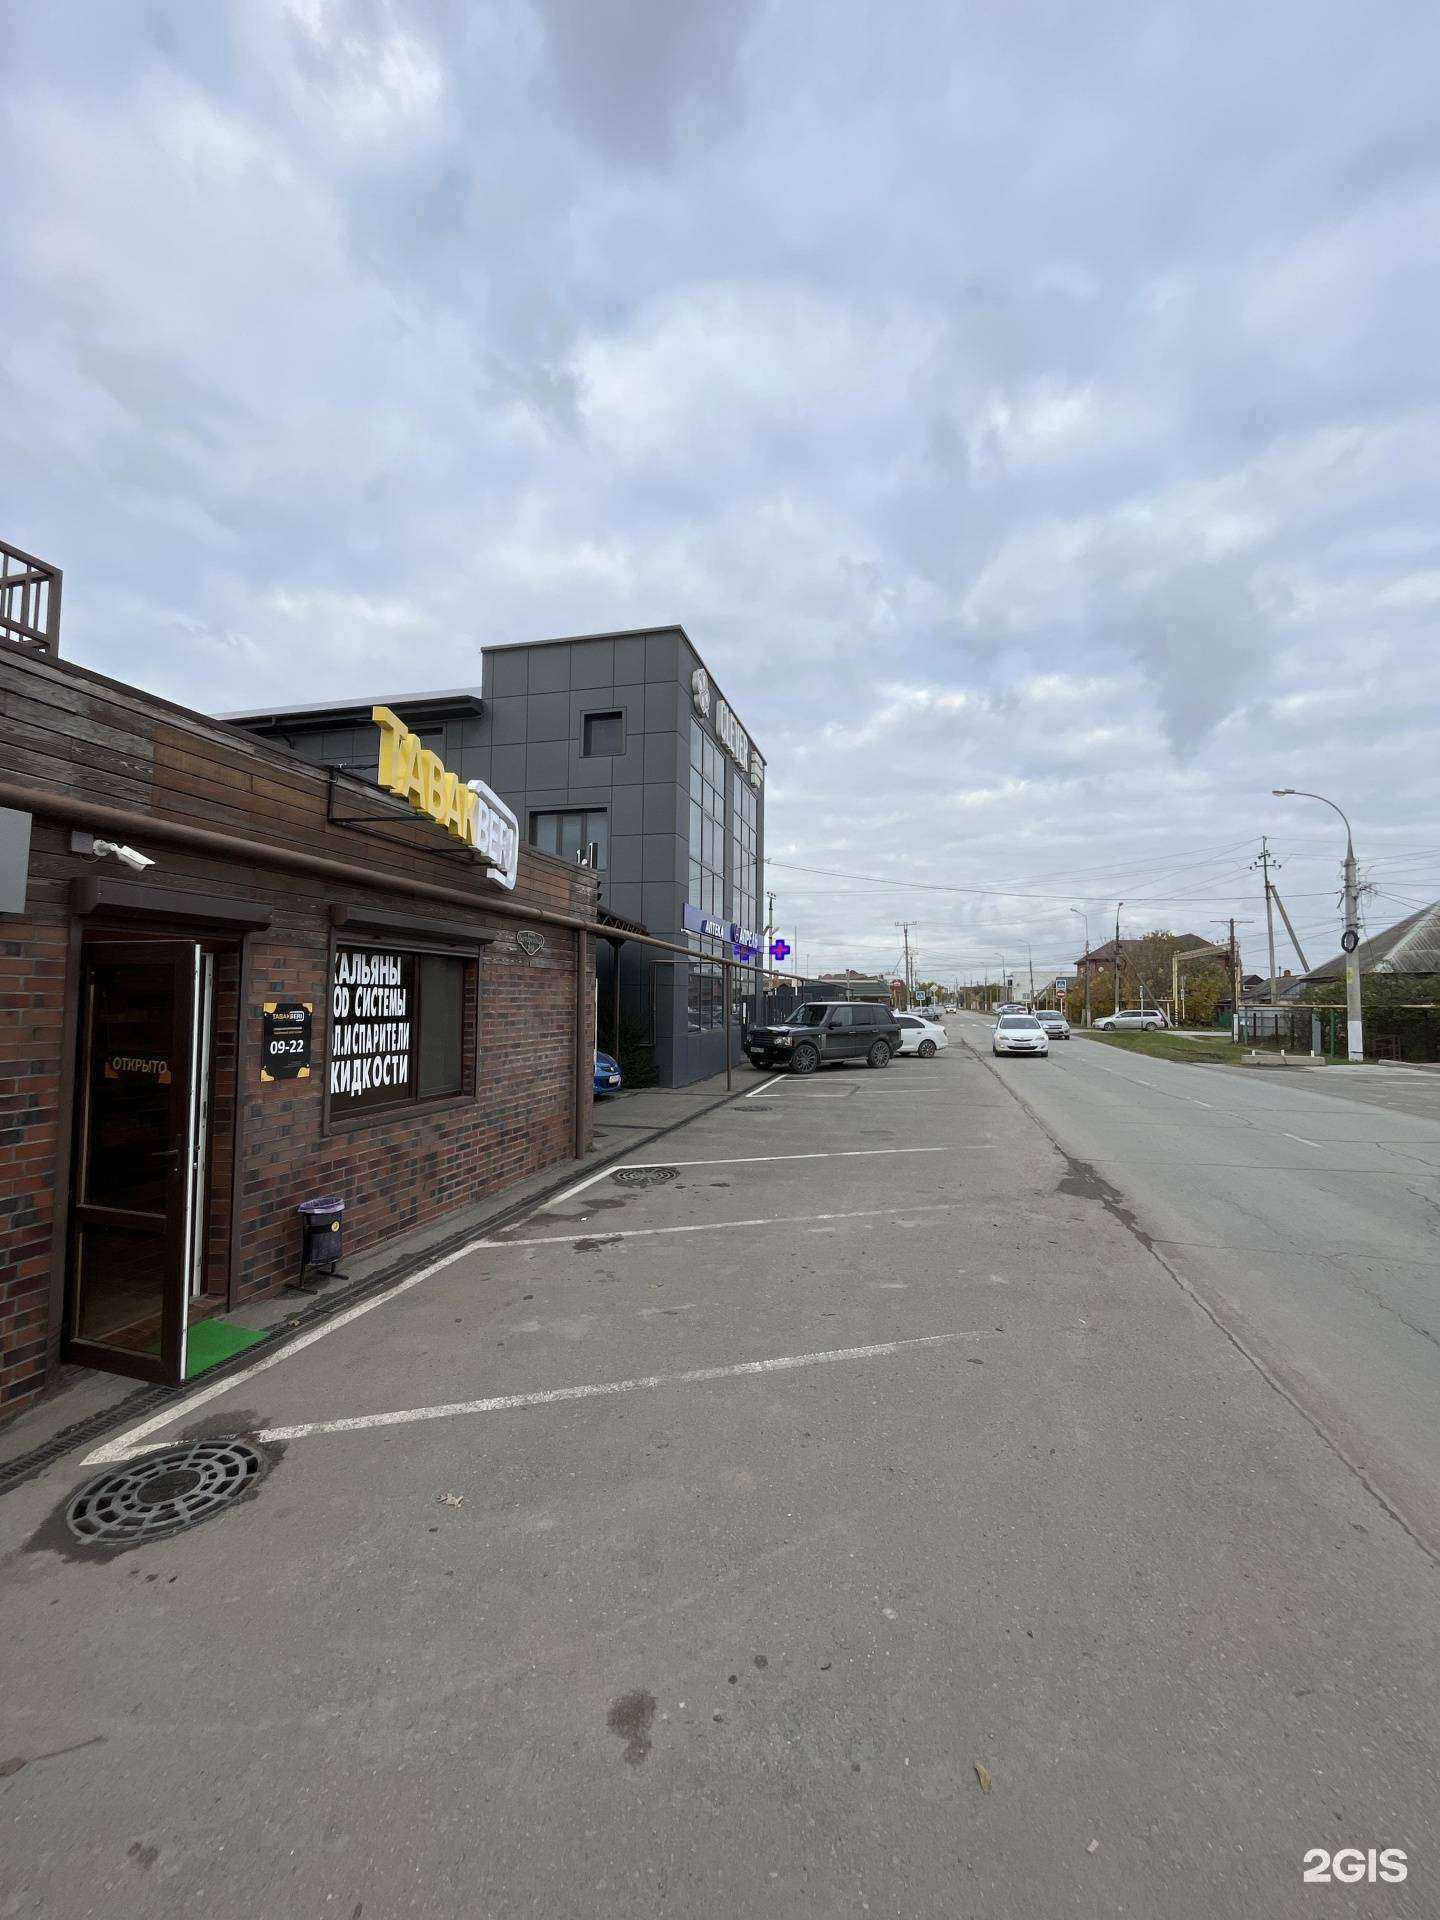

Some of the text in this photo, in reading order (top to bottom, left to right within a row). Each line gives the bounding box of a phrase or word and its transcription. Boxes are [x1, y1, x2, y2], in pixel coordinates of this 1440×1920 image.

[333, 986, 406, 1018] OD СИСТЕМЫ
[270, 1040, 304, 1055] 09-22
[332, 1022, 410, 1056] Л.ИСПАРИТЕЛИ
[112, 1056, 168, 1075] ОТКРЫТО
